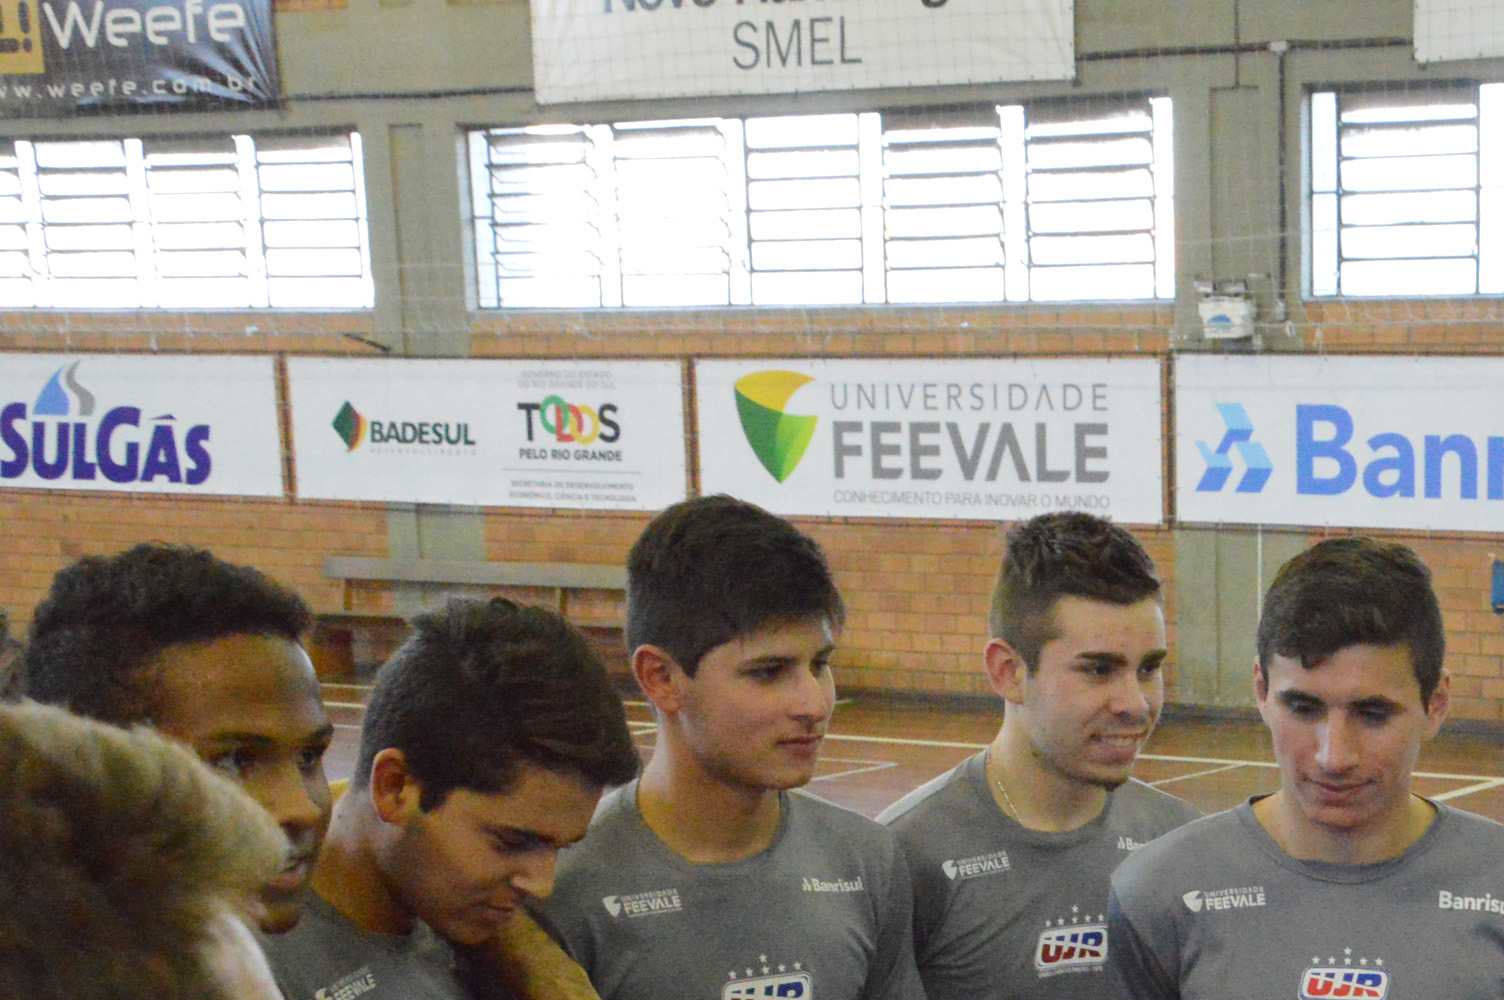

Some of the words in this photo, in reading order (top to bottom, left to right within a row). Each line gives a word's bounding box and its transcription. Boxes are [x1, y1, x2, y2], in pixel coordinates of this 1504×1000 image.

[42, 0, 245, 49] Weefe
[732, 16, 862, 69] SMEL
[830, 383, 1109, 412] UNIVERSIDADE
[517, 394, 620, 445] TODOS
[370, 421, 476, 445] BADESUL
[519, 448, 548, 460] PELO
[551, 449, 571, 460] RIO
[574, 450, 622, 461] GRANDE
[832, 421, 1110, 483] FEEVALE
[833, 489, 941, 506] CONHECIMENTO
[944, 491, 981, 507] PARA
[985, 493, 1037, 508] INOVAR
[1041, 494, 1051, 508] O
[1055, 494, 1110, 509] MUNDO
[959, 857, 1010, 877] FEEVALE
[811, 876, 864, 893] Banrisul
[1203, 886, 1265, 898] UNIVERSIDADE
[623, 895, 682, 915] FEEVALE
[1205, 893, 1267, 911] FEEVALE
[1041, 932, 1104, 964] UJR
[1307, 972, 1381, 997] UJR
